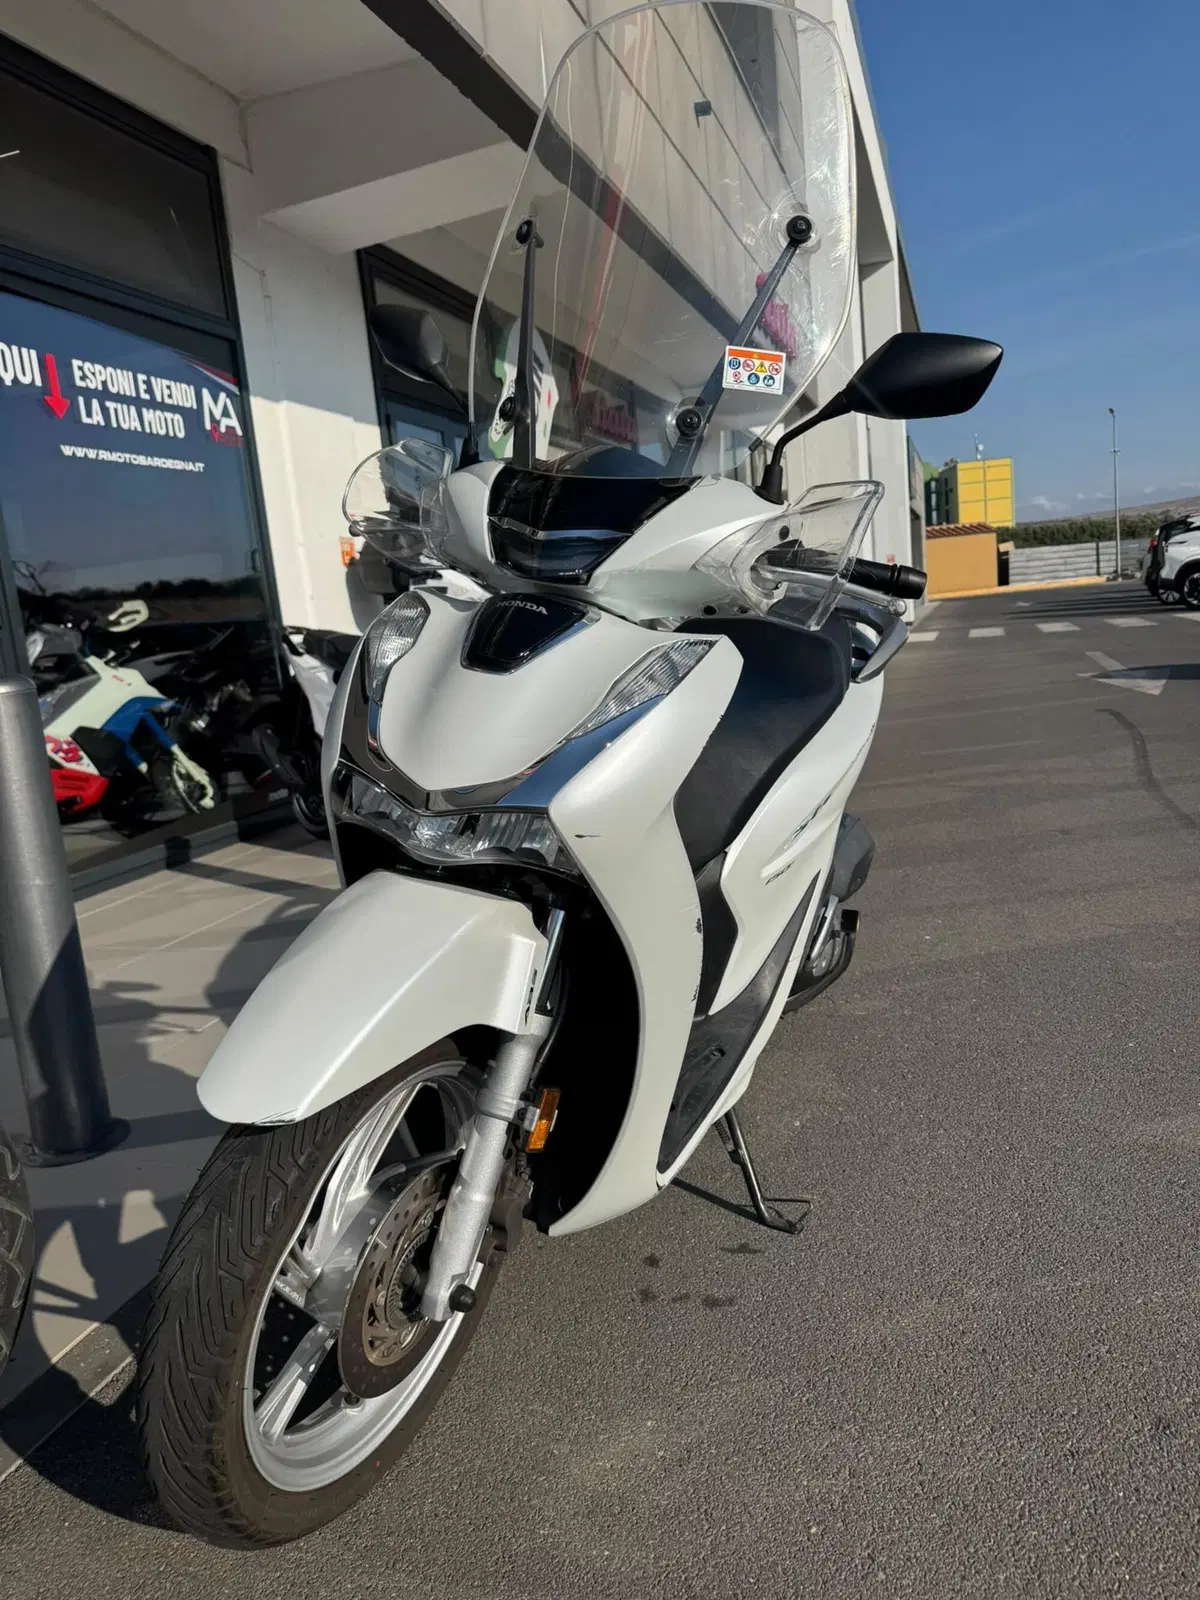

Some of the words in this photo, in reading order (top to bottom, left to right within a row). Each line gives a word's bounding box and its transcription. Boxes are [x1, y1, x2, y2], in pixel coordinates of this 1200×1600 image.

[0, 341, 43, 387] QUI
[71, 358, 137, 398] ESPONI
[136, 372, 151, 400] E
[150, 376, 198, 410] VENDI
[77, 395, 106, 427] LA
[104, 400, 142, 432] TUA
[141, 407, 186, 439] MOTO
[496, 600, 548, 615] HONDA
